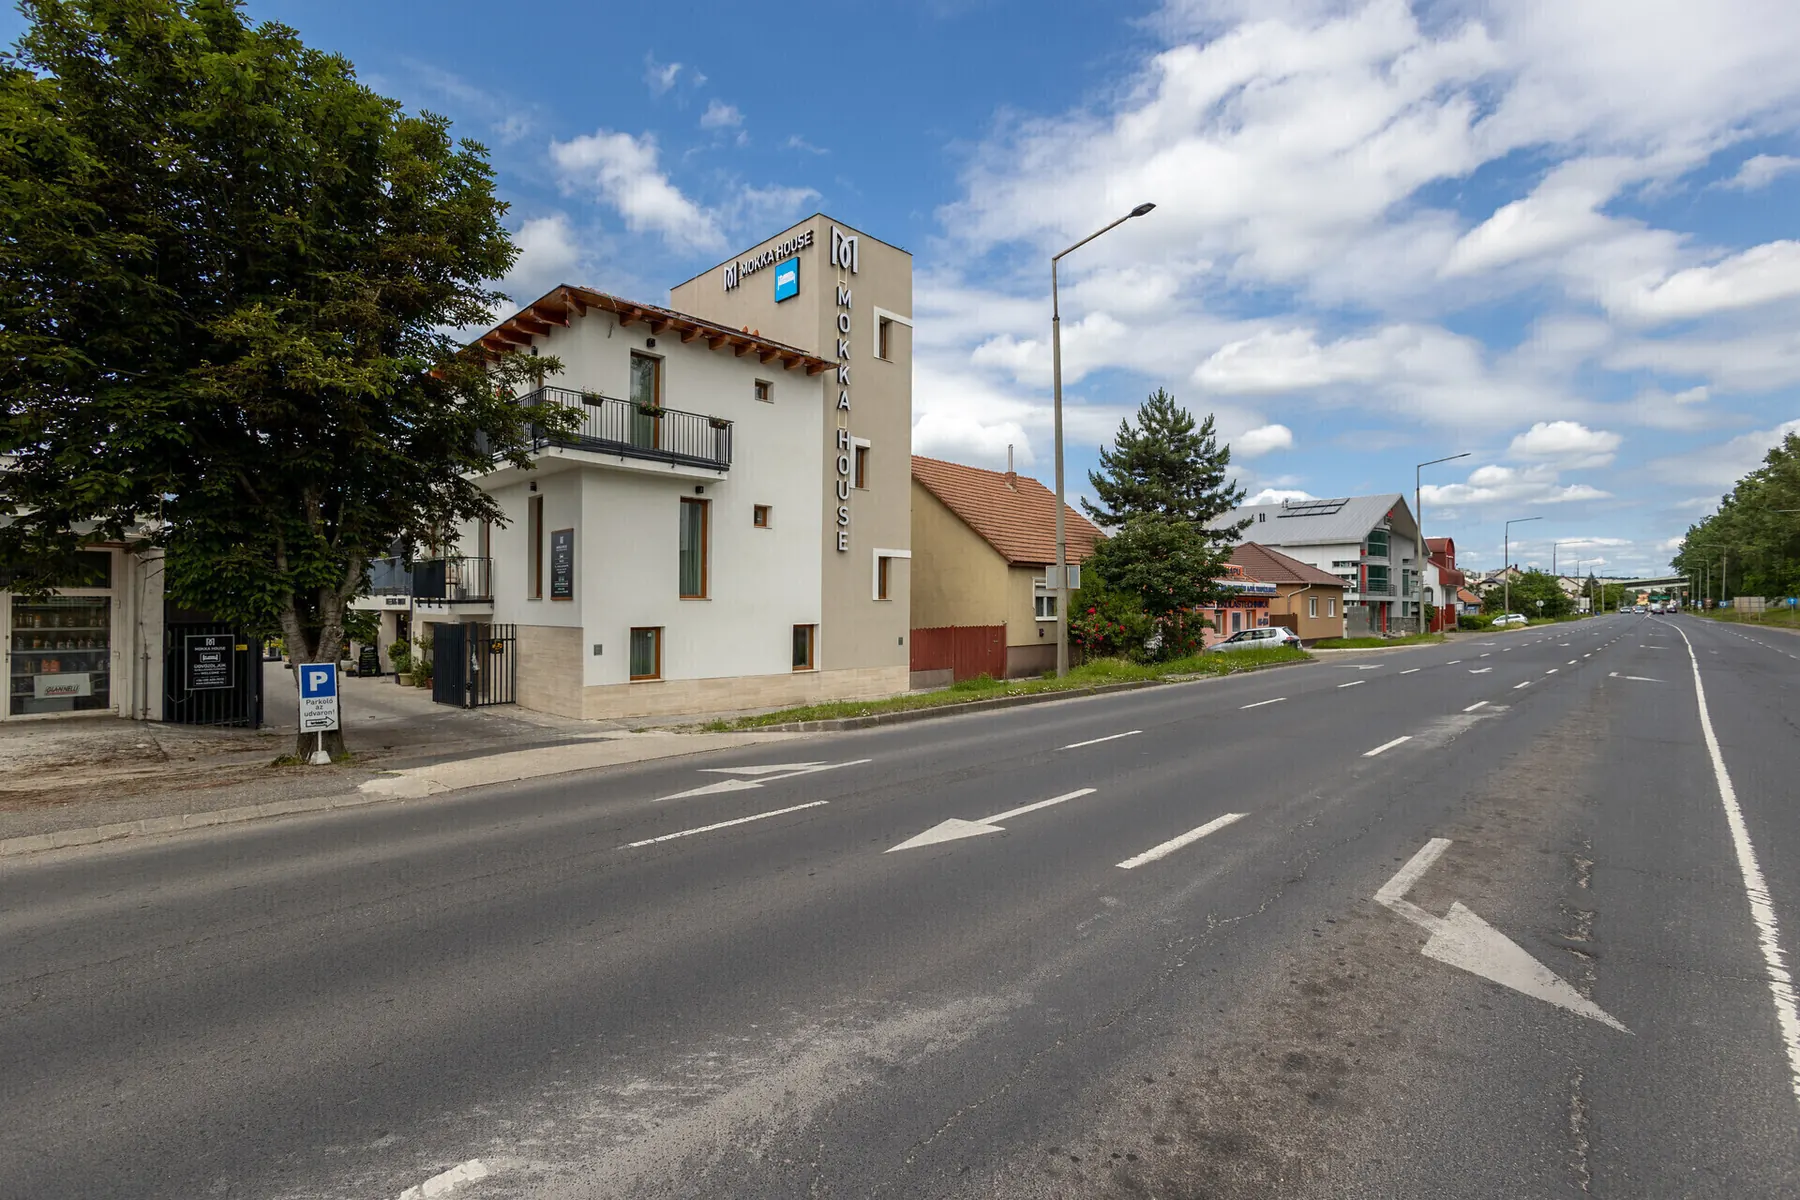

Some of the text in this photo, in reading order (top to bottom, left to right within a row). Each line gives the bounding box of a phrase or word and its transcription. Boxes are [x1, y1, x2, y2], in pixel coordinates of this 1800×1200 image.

[740, 250, 775, 276] MOKKA
[776, 229, 813, 257] HOUSE
[837, 286, 852, 551] MOKKA HOUSE
[309, 671, 328, 691] P
[305, 697, 333, 705] Parkoló
[303, 709, 335, 717] udvaron!
